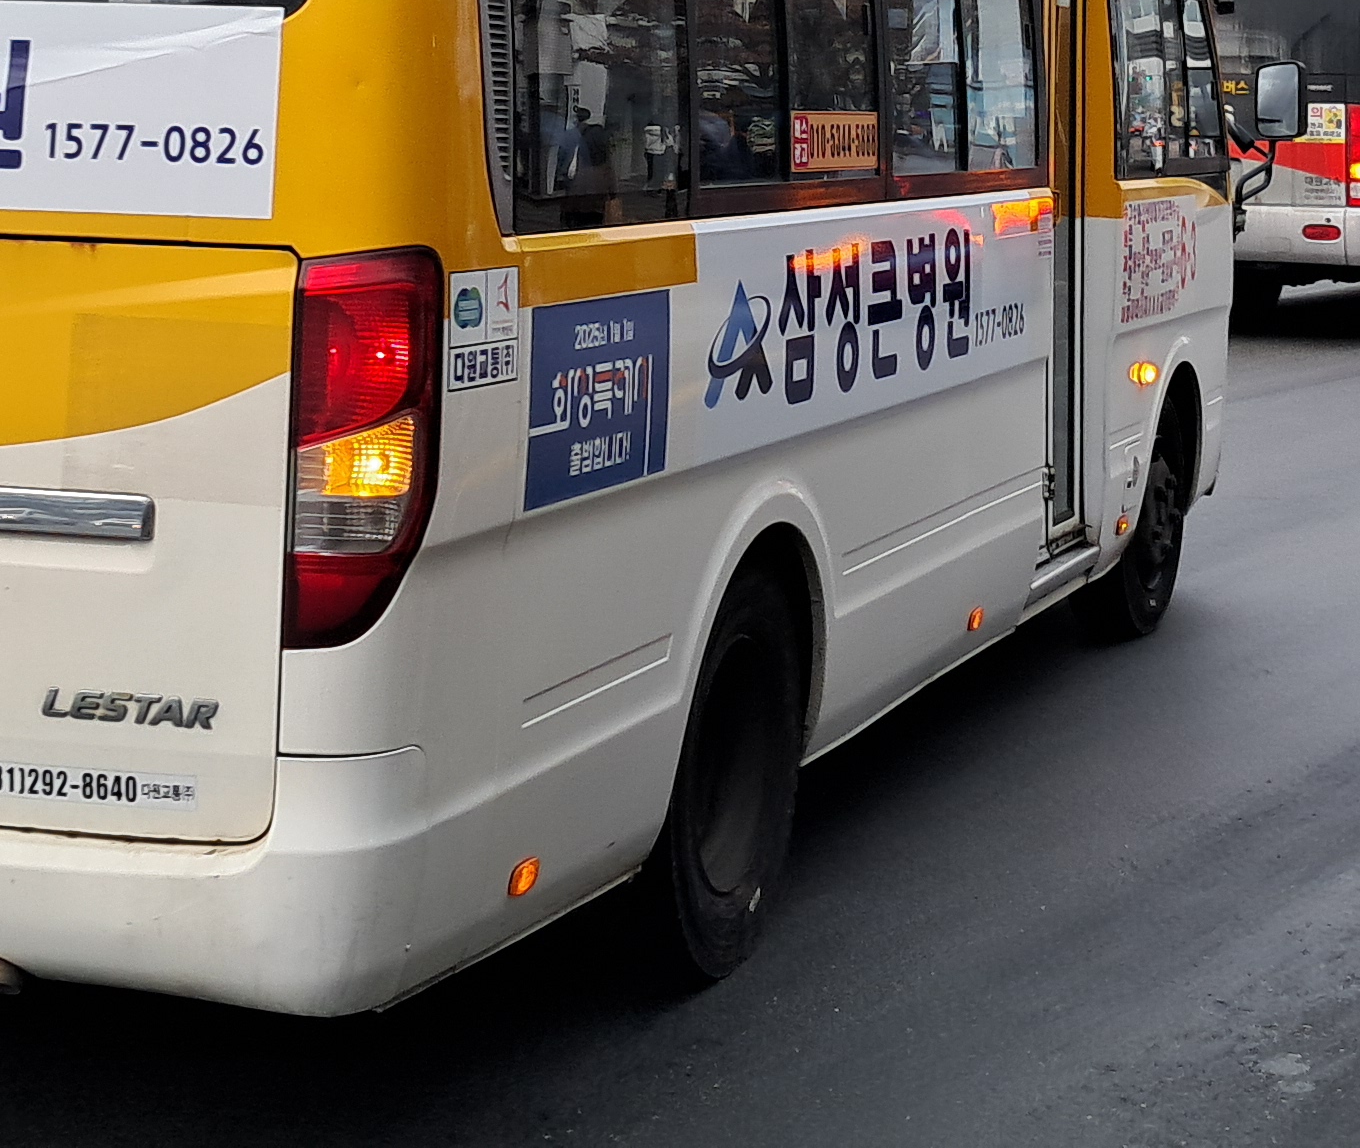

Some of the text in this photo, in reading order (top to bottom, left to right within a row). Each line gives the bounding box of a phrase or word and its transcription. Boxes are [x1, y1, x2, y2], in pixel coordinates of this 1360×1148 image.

[43, 120, 266, 168] 1577-0826
[778, 227, 1026, 405] 삼성큰병원 1577-0826
[453, 344, 515, 384] 다원교통(주)
[568, 430, 632, 477] 출범합니다!
[40, 686, 221, 731] LESTAR
